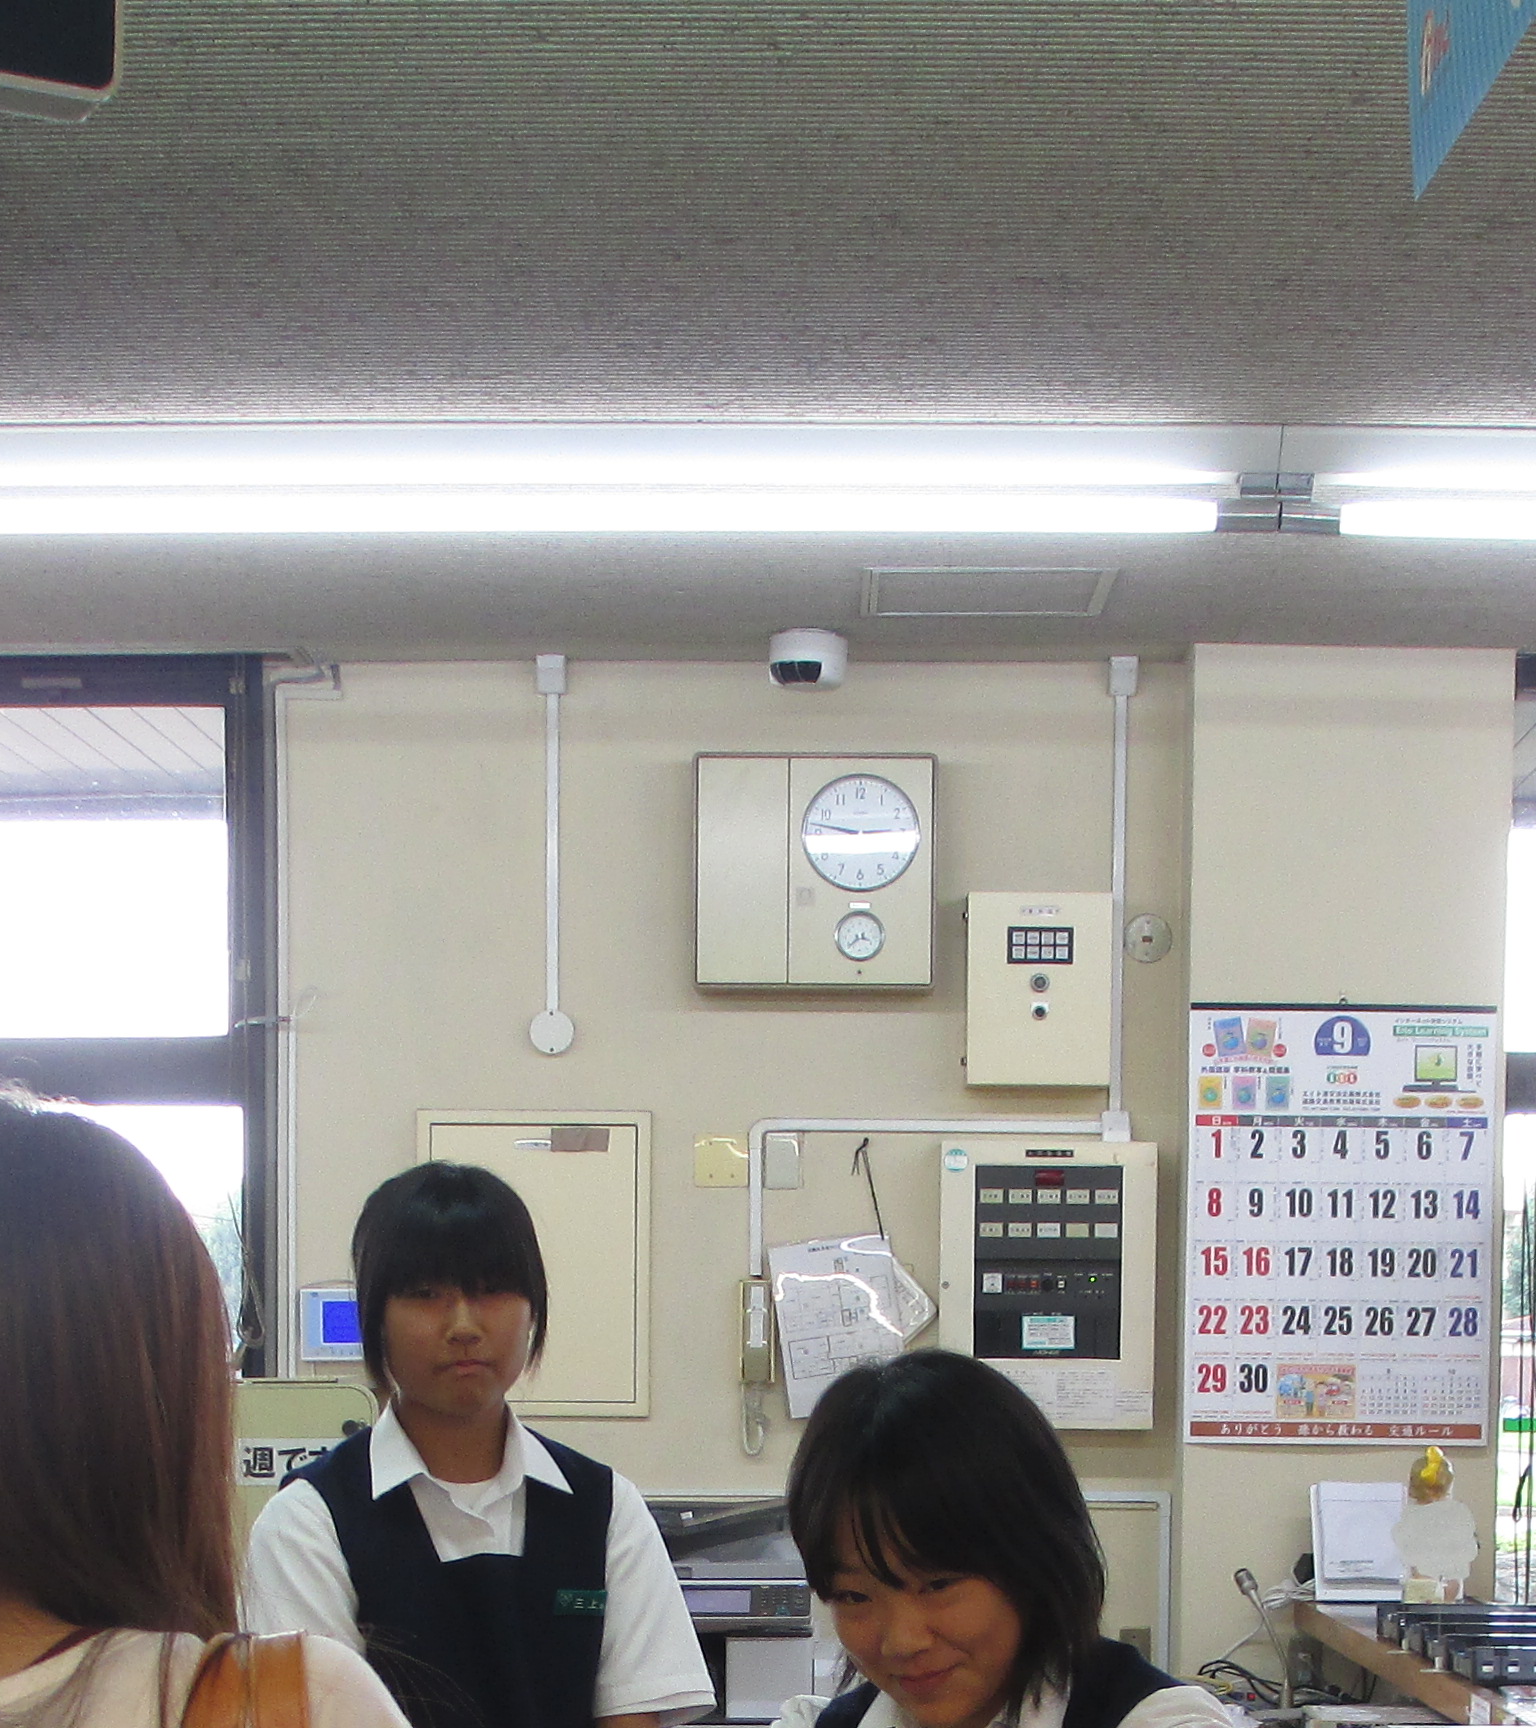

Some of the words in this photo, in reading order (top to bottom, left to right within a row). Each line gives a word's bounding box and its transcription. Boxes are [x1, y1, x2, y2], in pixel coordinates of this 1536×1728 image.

[836, 794, 845, 805] 11
[855, 787, 866, 799] 12
[821, 809, 831, 820] 10
[1332, 1021, 1353, 1054] 9
[1212, 1129, 1221, 1158] 1
[1251, 1129, 1264, 1158] 2
[1292, 1130, 1305, 1158] 3
[1334, 1130, 1348, 1159] 4
[1376, 1131, 1389, 1159] 5
[1417, 1131, 1431, 1160] 6
[1459, 1131, 1474, 1160] 7
[1208, 1188, 1221, 1216] 8
[1249, 1188, 1263, 1217] 9
[1286, 1189, 1312, 1217] 10
[1328, 1189, 1352, 1218] 11
[1370, 1190, 1395, 1218] 12
[1411, 1190, 1437, 1218] 13
[1454, 1190, 1480, 1219] 14
[1201, 1247, 1227, 1275] 15
[1243, 1247, 1269, 1275] 16
[1285, 1247, 1312, 1276] 17
[1327, 1248, 1353, 1276] 18
[1369, 1248, 1394, 1277] 19
[1409, 1249, 1436, 1277] 20
[1451, 1249, 1477, 1277] 21
[1199, 1305, 1227, 1334] 22
[1241, 1306, 1268, 1334] 23
[1283, 1306, 1310, 1334] 24
[1324, 1306, 1352, 1335] 25
[1366, 1307, 1393, 1335] 26
[1407, 1307, 1436, 1336] 27
[1450, 1308, 1477, 1336] 28
[1198, 1364, 1226, 1392] 29
[1240, 1364, 1267, 1393] 30
[1220, 1424, 1283, 1436] ありがとう
